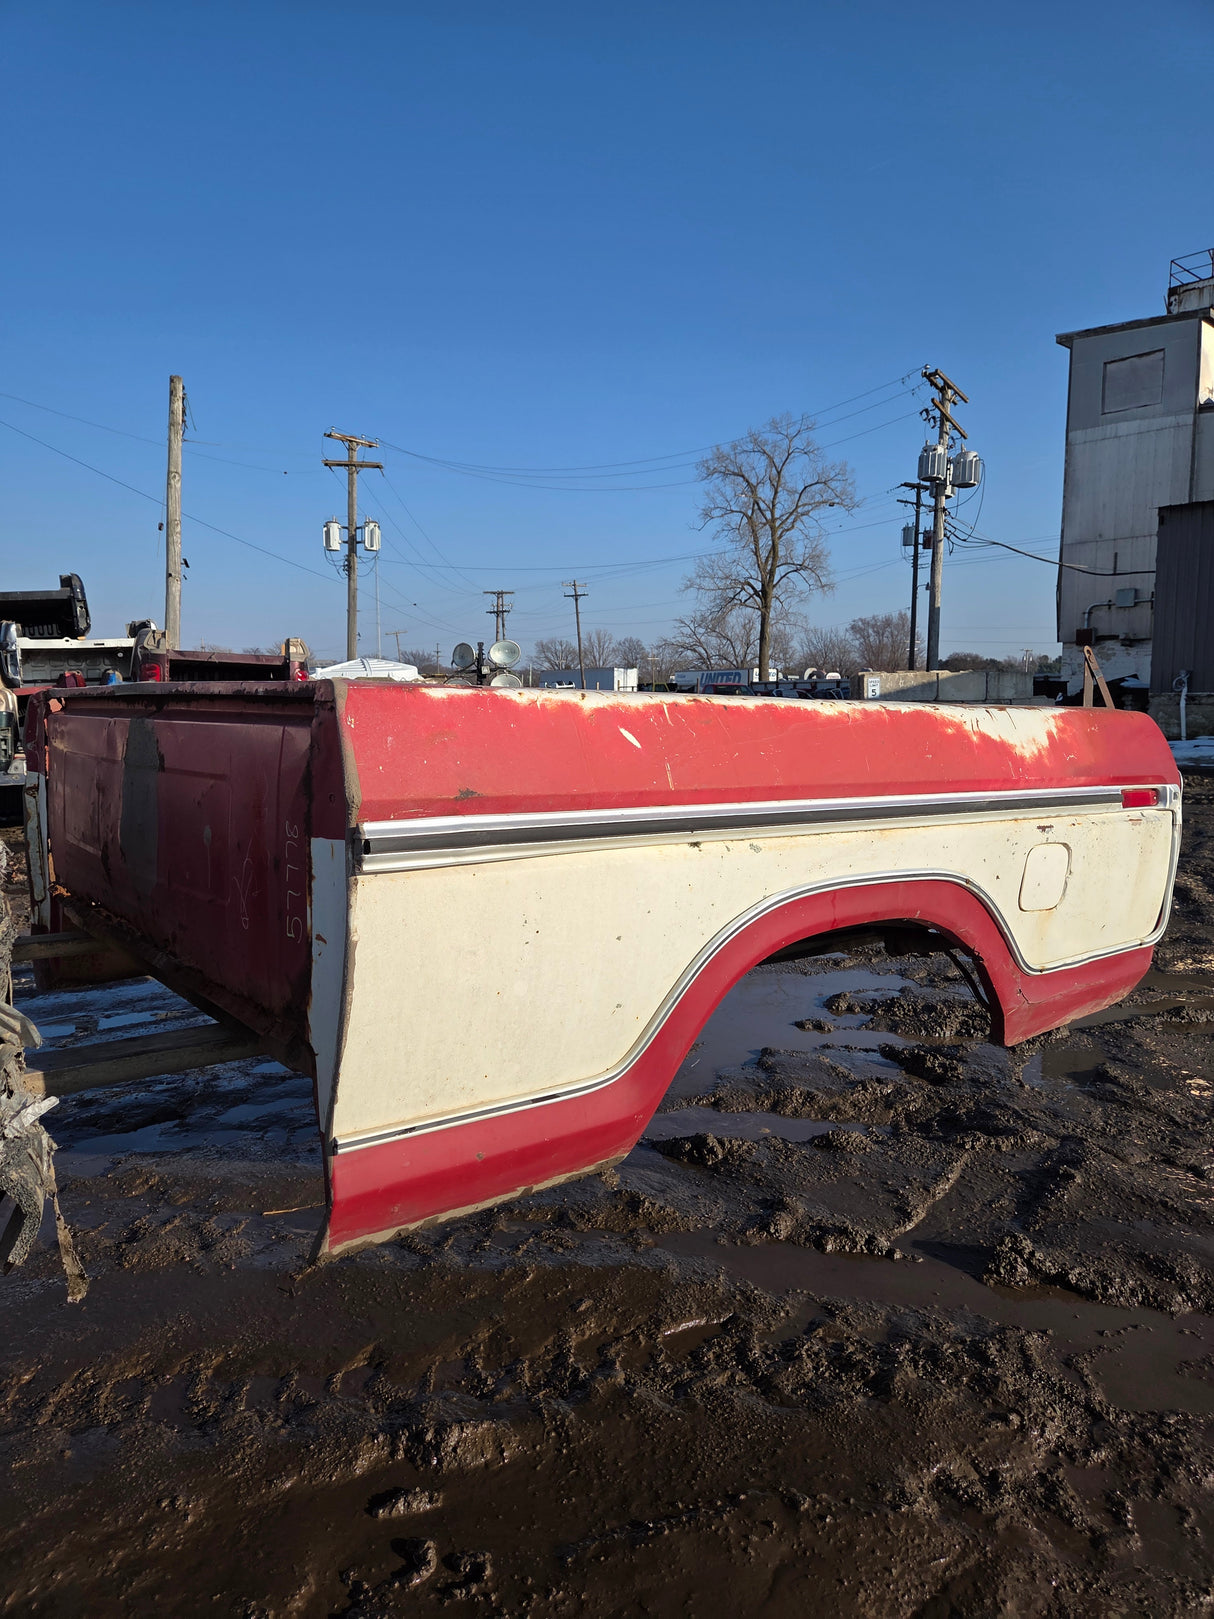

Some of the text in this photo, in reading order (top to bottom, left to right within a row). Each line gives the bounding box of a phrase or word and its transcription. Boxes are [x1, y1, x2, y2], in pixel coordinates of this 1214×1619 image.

[700, 672, 742, 685] UNITED
[871, 688, 877, 697] 5
[285, 820, 303, 944] 57778
